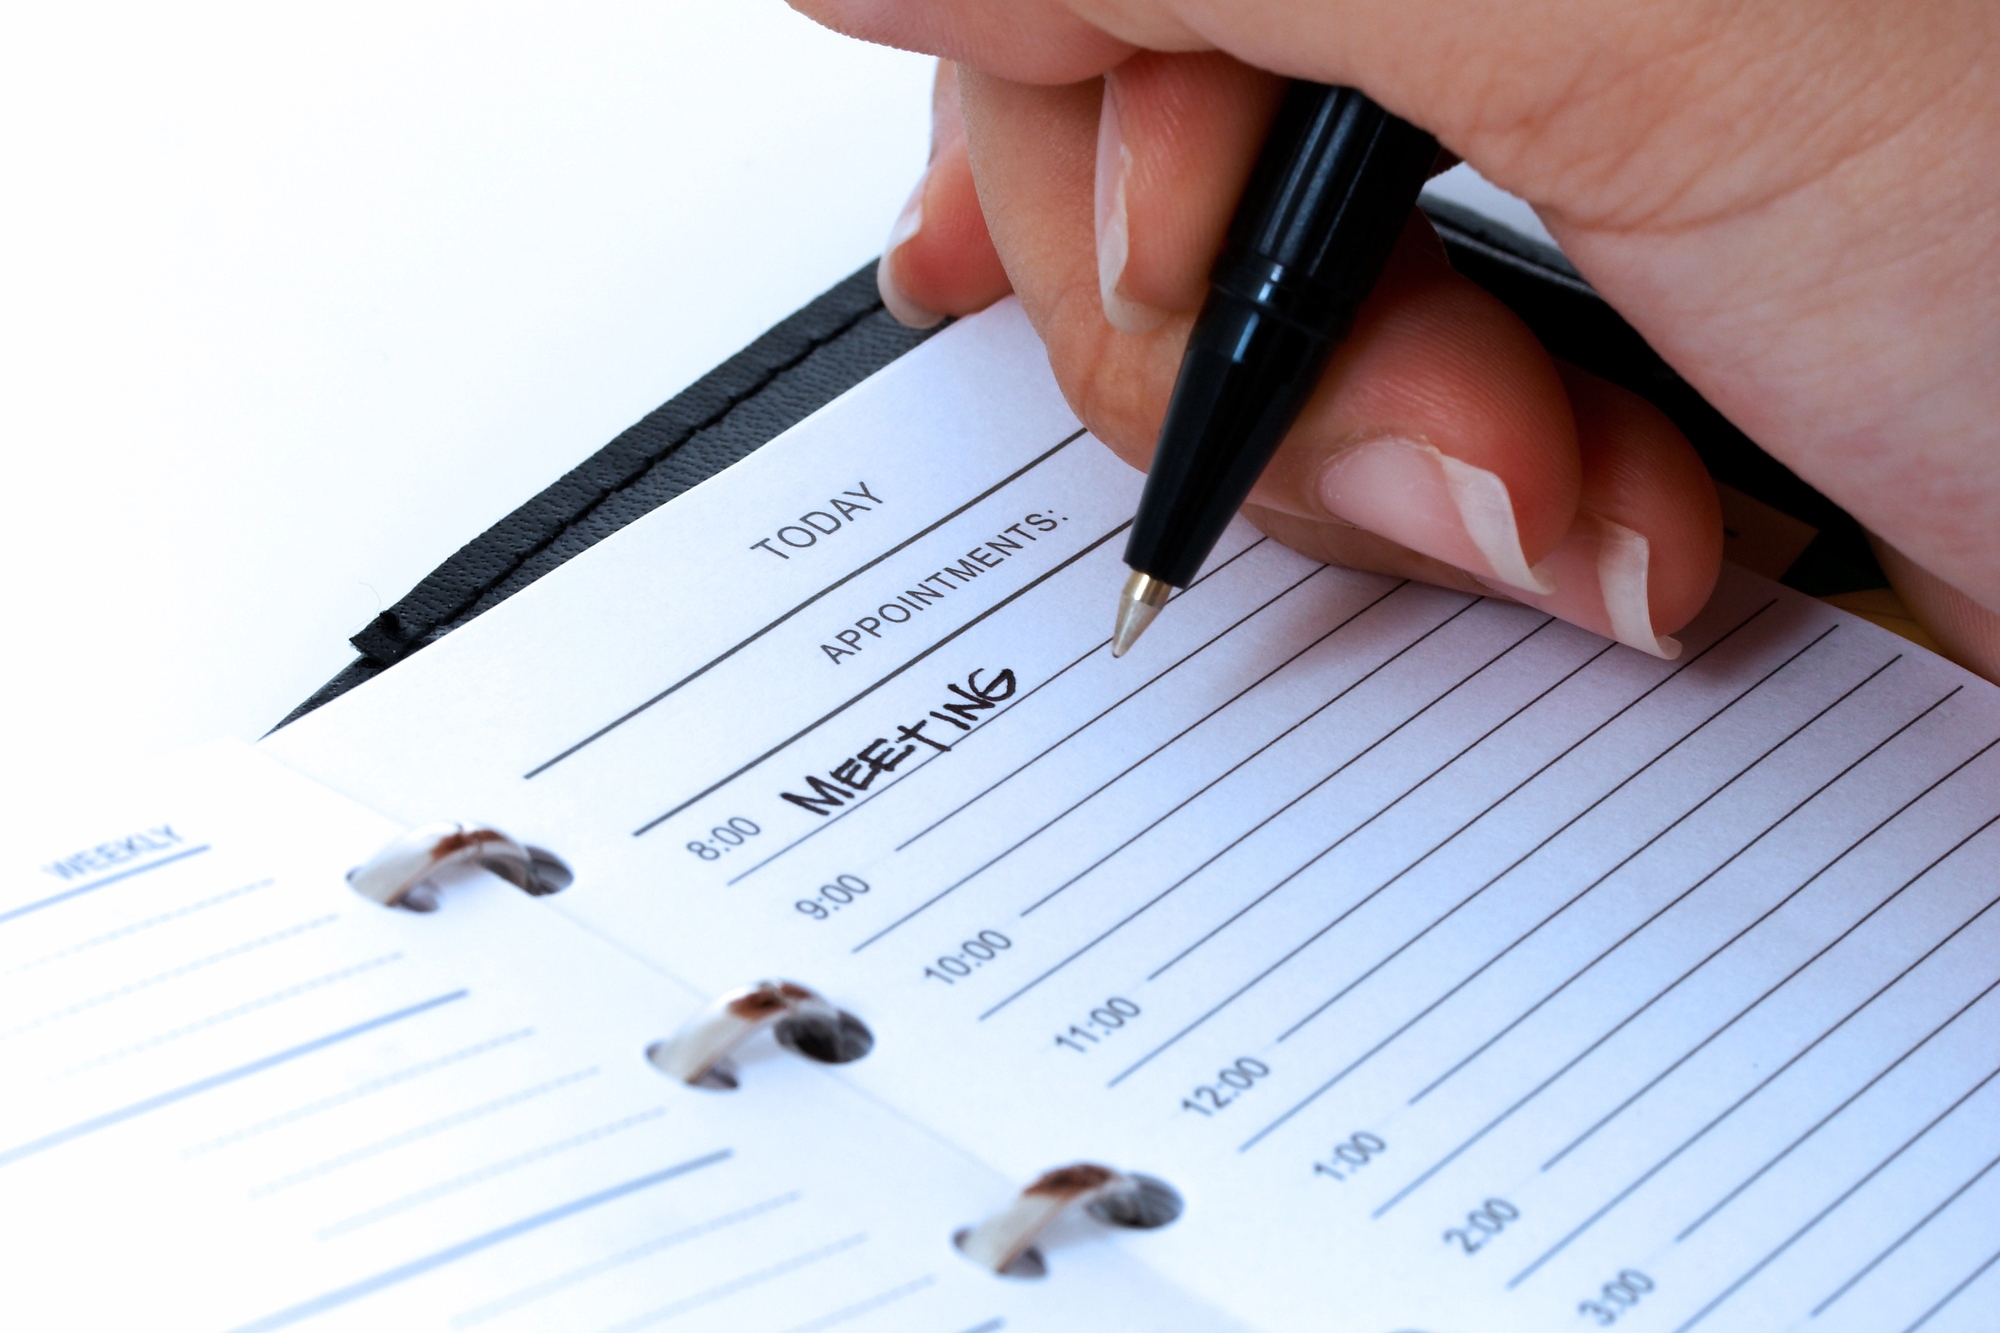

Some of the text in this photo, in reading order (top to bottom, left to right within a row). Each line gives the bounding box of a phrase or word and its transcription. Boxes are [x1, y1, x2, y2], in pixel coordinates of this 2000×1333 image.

[750, 481, 884, 560] TODAY
[820, 509, 1069, 666] APPOINTMENTS:
[779, 668, 1017, 817] MEETING
[42, 823, 184, 881] WEEKLY
[686, 816, 761, 863] 8:00
[794, 873, 870, 920] 9:00
[923, 929, 1012, 986] 10:00
[1054, 996, 1141, 1052] 11:00
[1180, 1056, 1270, 1119] 12:00
[1312, 1130, 1387, 1181] 1:00
[1441, 1197, 1520, 1256] 2:00
[1576, 1268, 1655, 1326] 3:00
